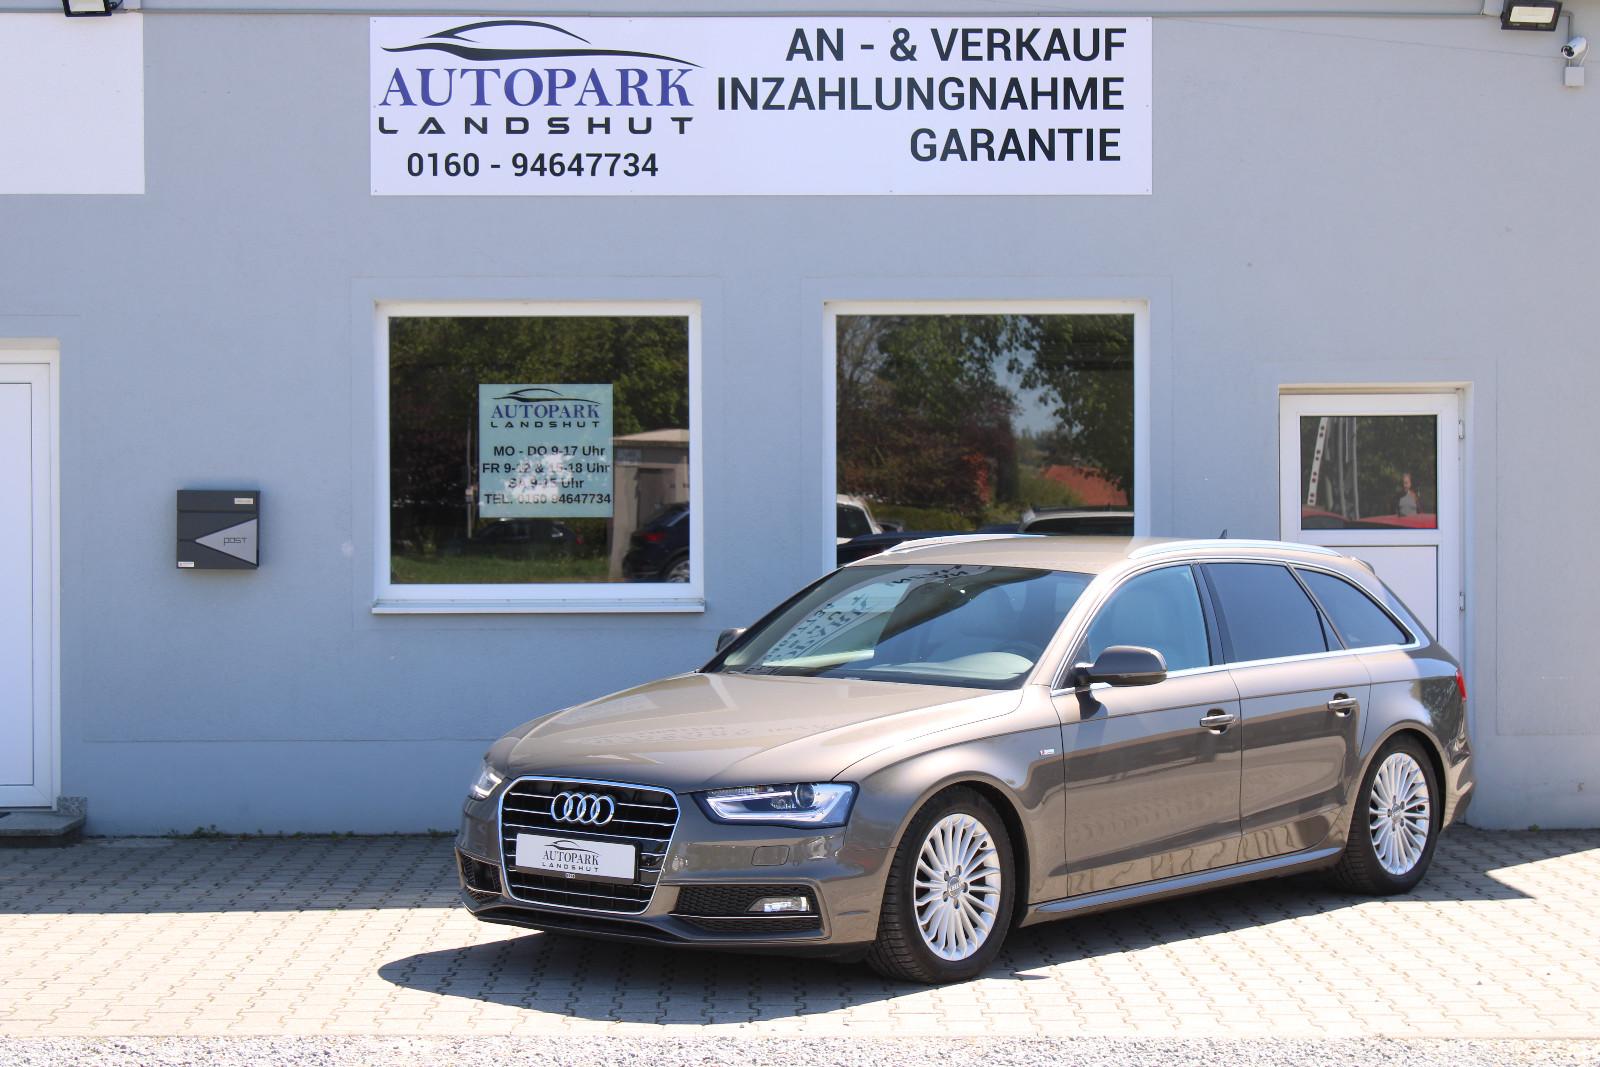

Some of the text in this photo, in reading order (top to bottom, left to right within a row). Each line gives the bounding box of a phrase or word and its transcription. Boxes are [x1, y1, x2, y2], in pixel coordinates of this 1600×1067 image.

[786, 28, 844, 62] AN
[889, 27, 918, 62] &
[930, 28, 1127, 62] VERKAUF
[378, 67, 695, 107] AUTOPARK
[717, 76, 1125, 111] INZAHLUNGNAHME
[378, 117, 694, 135] LANDSHUT
[910, 127, 1121, 162] GARANTIE
[407, 152, 480, 177] 0160
[511, 152, 659, 177] 94647734
[491, 404, 600, 418] AUTOPARK
[493, 446, 515, 456] MO
[527, 446, 547, 456] DO
[551, 446, 578, 456] 9-17
[582, 445, 606, 456] Uhr
[482, 463, 500, 473] FR
[535, 463, 544, 473] &
[586, 462, 611, 473] Uhr
[561, 477, 585, 488] Uhr
[484, 493, 513, 504] TEL.
[542, 850, 599, 865] AUTOPARK
[541, 862, 599, 873] LANDSHUT
